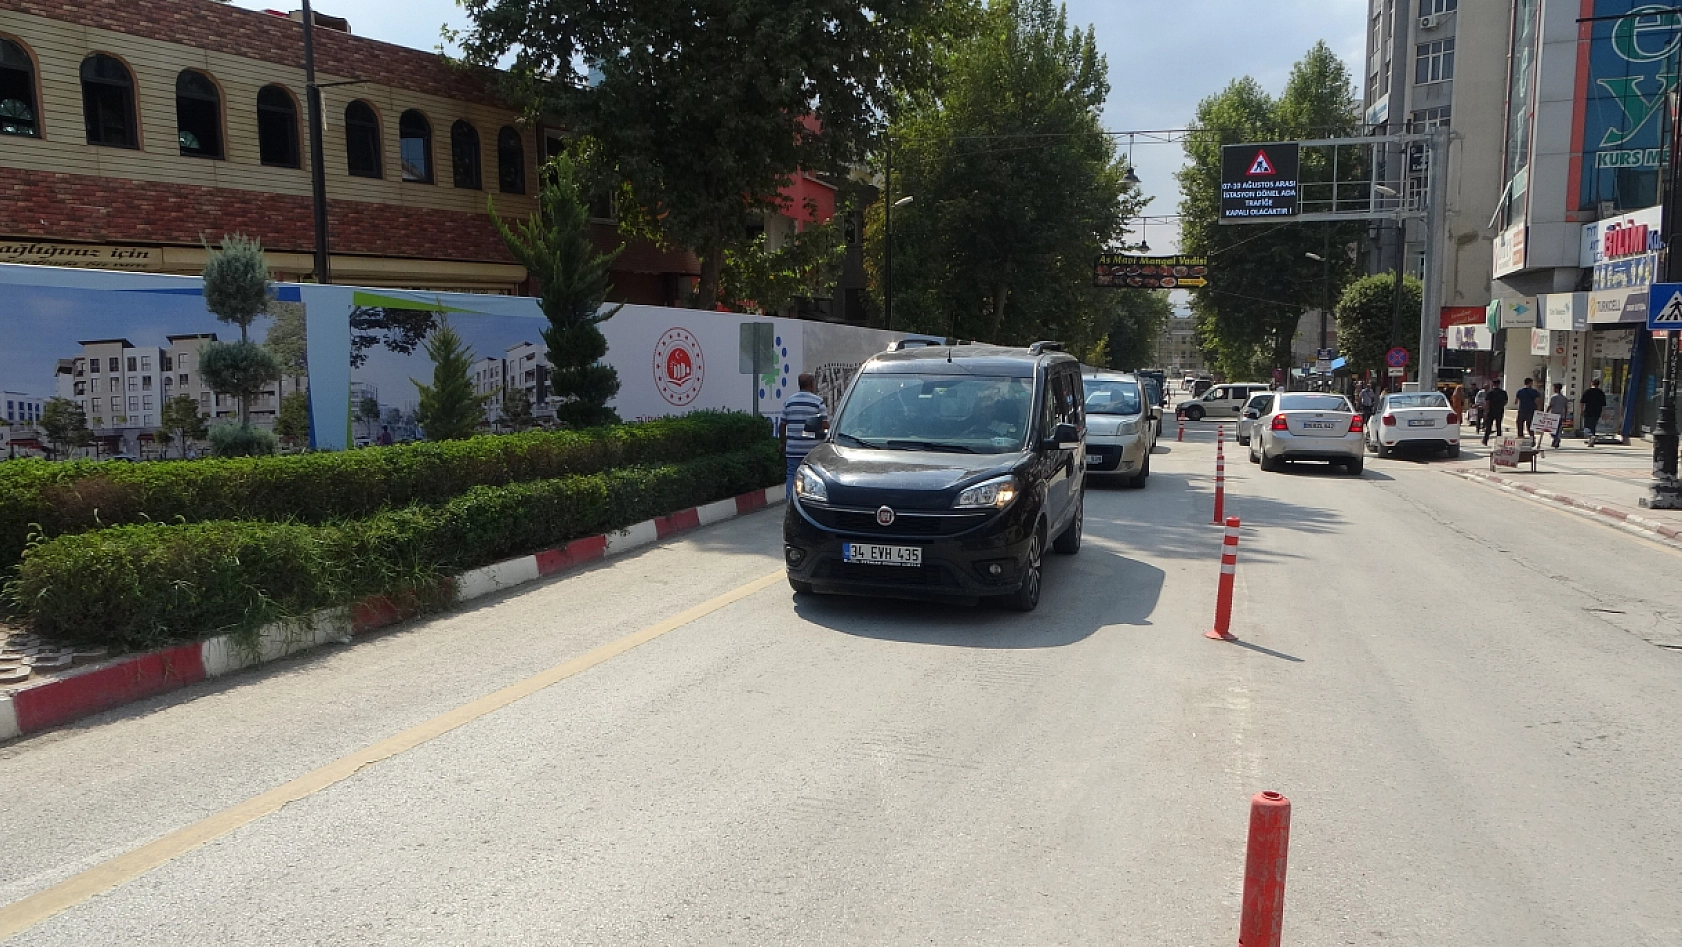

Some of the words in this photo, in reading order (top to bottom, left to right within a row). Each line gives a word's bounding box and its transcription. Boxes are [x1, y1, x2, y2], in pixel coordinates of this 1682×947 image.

[1598, 151, 1642, 167] KURS
[1646, 149, 1671, 167] ME
[1243, 181, 1273, 189] AĞUSTOS
[1604, 219, 1648, 259] BİLİM
[111, 247, 150, 260] için
[1100, 255, 1111, 265] As
[851, 544, 865, 559] 34
[898, 547, 919, 562] 435
